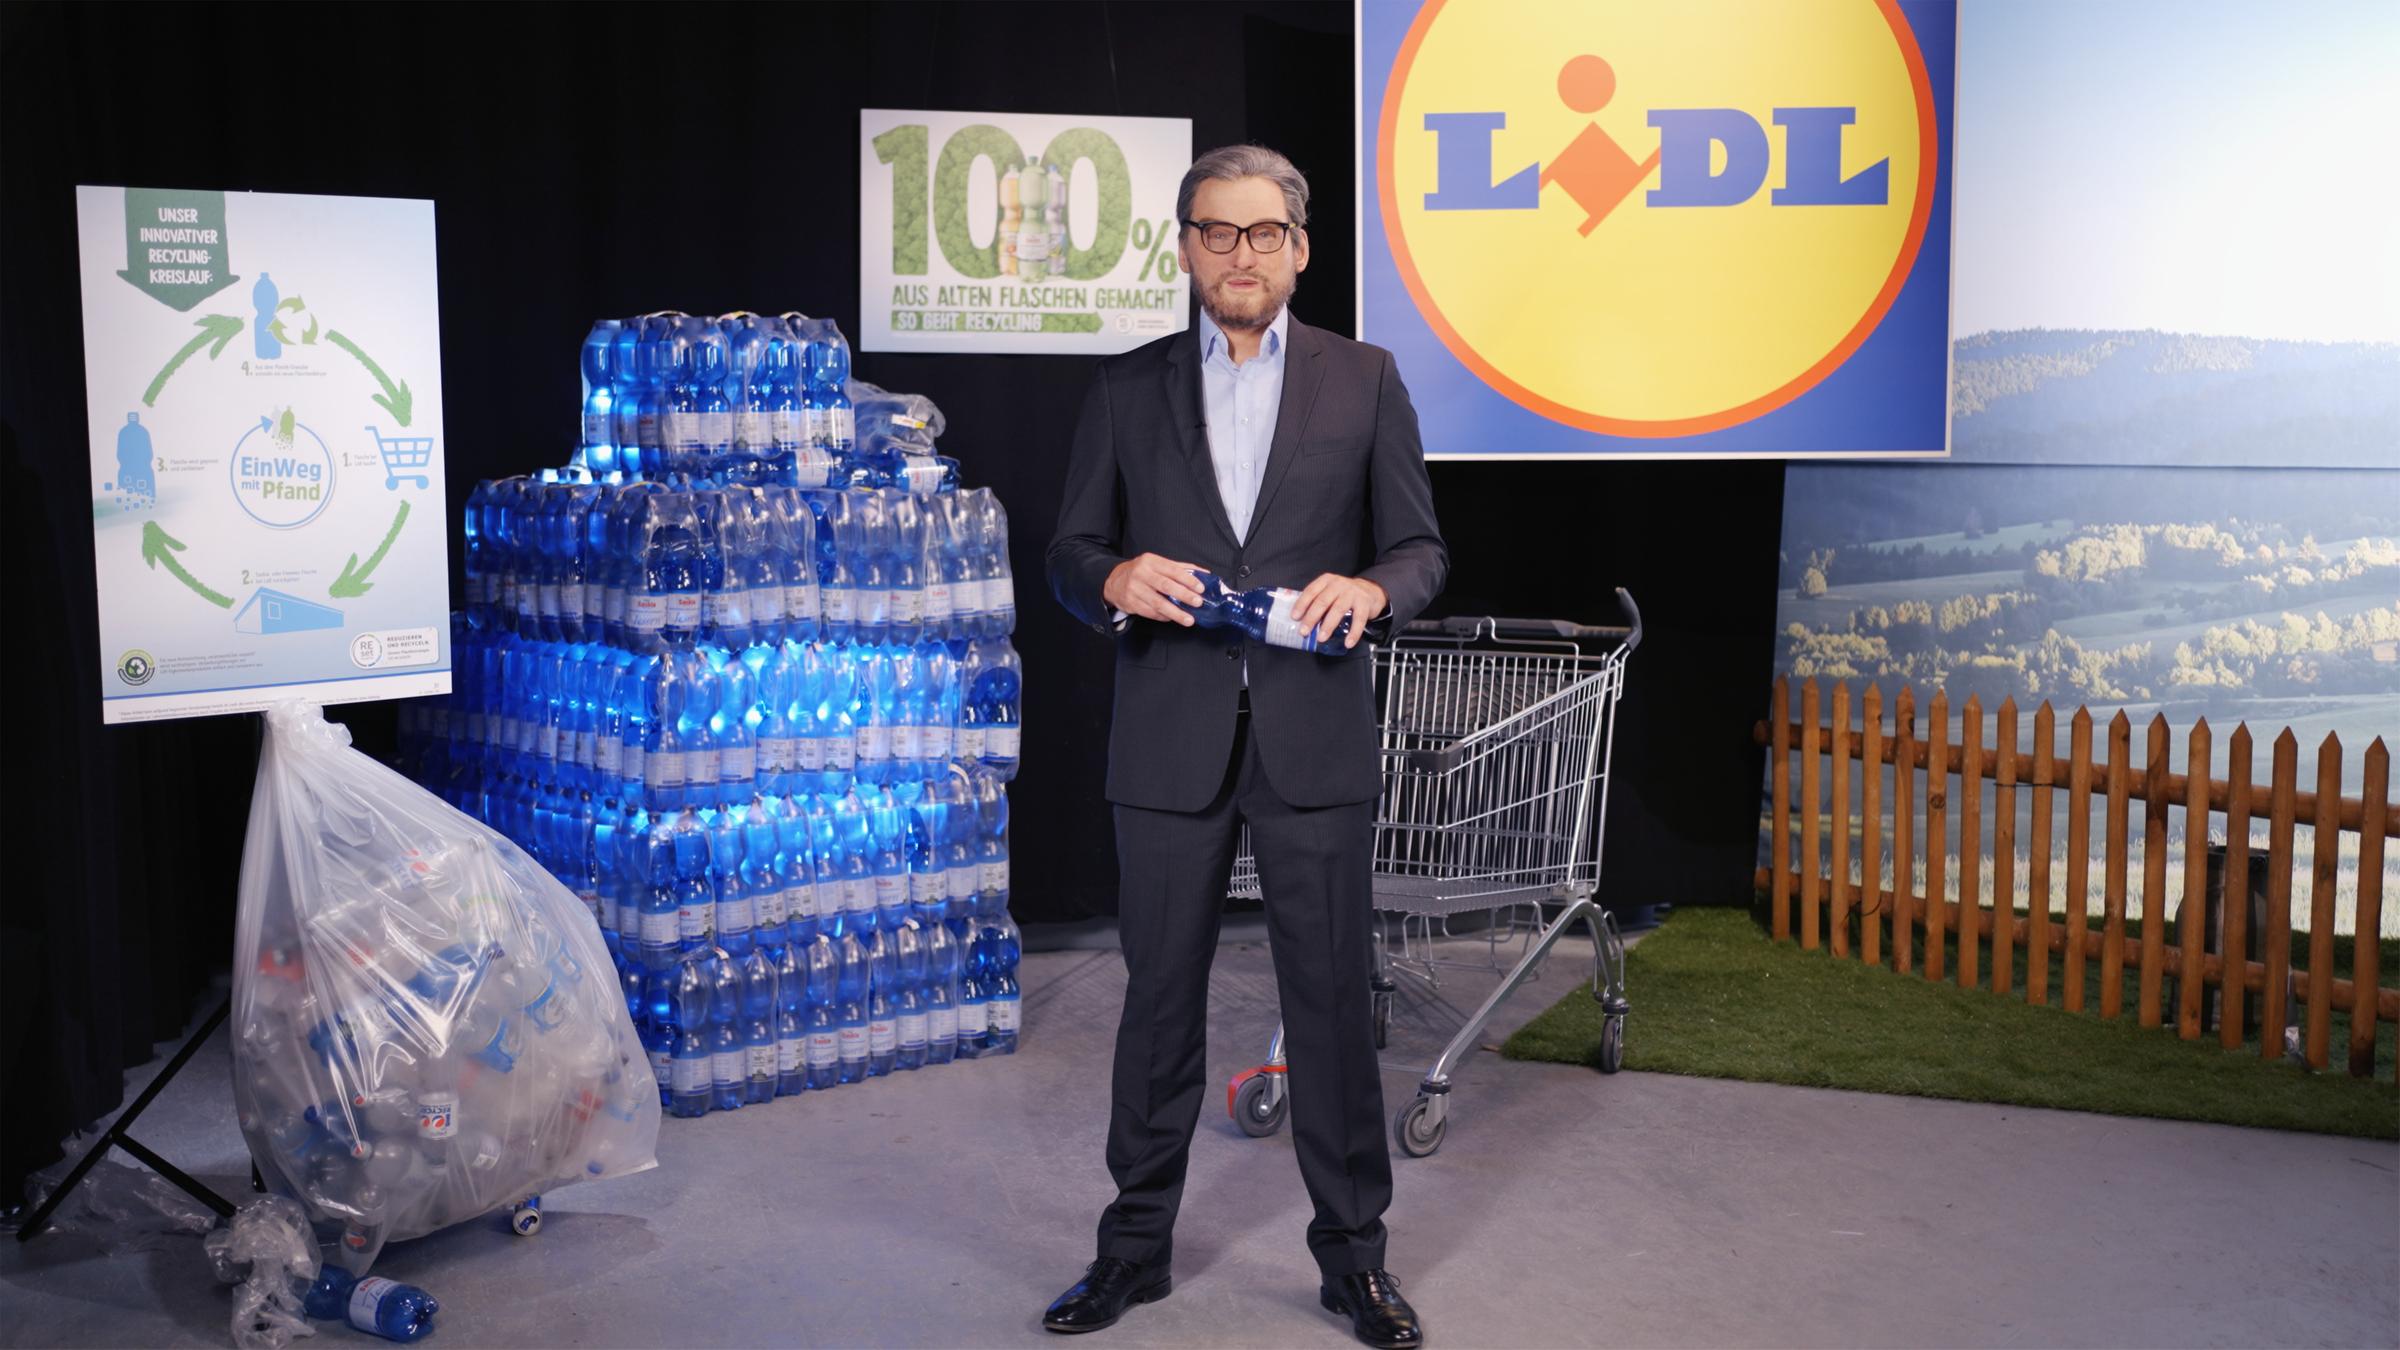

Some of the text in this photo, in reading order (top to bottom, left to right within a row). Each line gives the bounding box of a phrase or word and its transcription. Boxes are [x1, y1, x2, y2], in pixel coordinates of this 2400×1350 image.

[158, 207, 198, 224] UNSER
[139, 227, 218, 245] INNOVATIVER
[148, 248, 212, 265] RECYCLING-
[149, 268, 214, 285] KREISLAUF:
[892, 285, 929, 306] AUS
[937, 286, 992, 307] ALTEN
[1000, 286, 1088, 309] FLASCHEN
[897, 311, 1042, 332] SO GEHT RECYCLING
[241, 456, 322, 482] EinWeg
[241, 479, 321, 501] mit Pfand
[360, 641, 374, 650] RE
[360, 649, 374, 657] set
